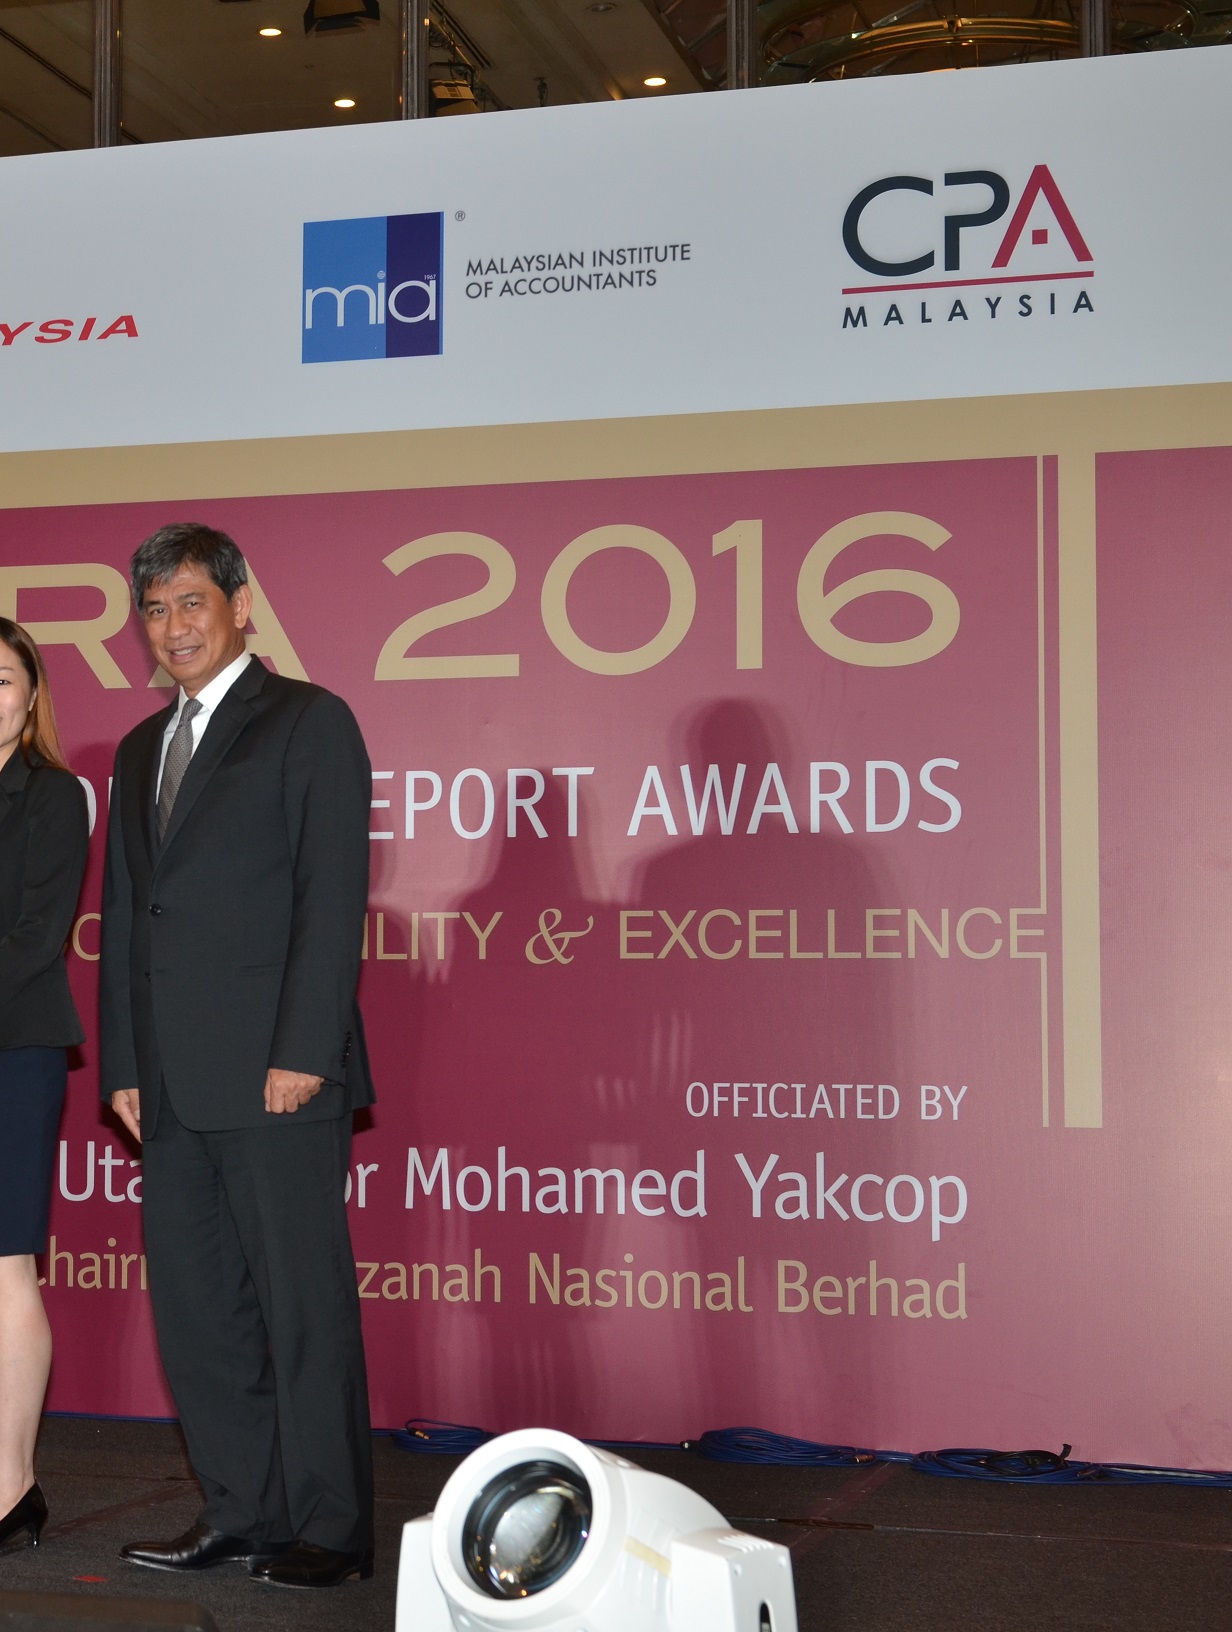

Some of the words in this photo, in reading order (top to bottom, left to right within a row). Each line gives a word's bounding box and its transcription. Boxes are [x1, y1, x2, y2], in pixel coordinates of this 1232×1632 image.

[841, 163, 1095, 278] CPA
[465, 251, 585, 277] MALAYSIAN
[592, 243, 692, 268] INSTITUTE
[465, 281, 494, 300] OF
[499, 269, 658, 298] ACCOUNTANTS
[305, 270, 437, 330] mia
[841, 290, 1095, 329] MALAYSIA
[373, 510, 961, 682] 2016
[368, 767, 595, 840] EPORT
[626, 757, 962, 837] AWARDS
[524, 908, 595, 965] &
[619, 906, 1046, 960] EXCELLENCE
[685, 1081, 901, 1120] OFFICIATED
[920, 1085, 968, 1120] BY
[405, 1146, 708, 1218] Mohamed
[734, 1151, 969, 1243] Yakcop
[355, 1247, 502, 1303] zanah
[529, 1251, 754, 1313] Nasional
[777, 1259, 969, 1321] Berhad
